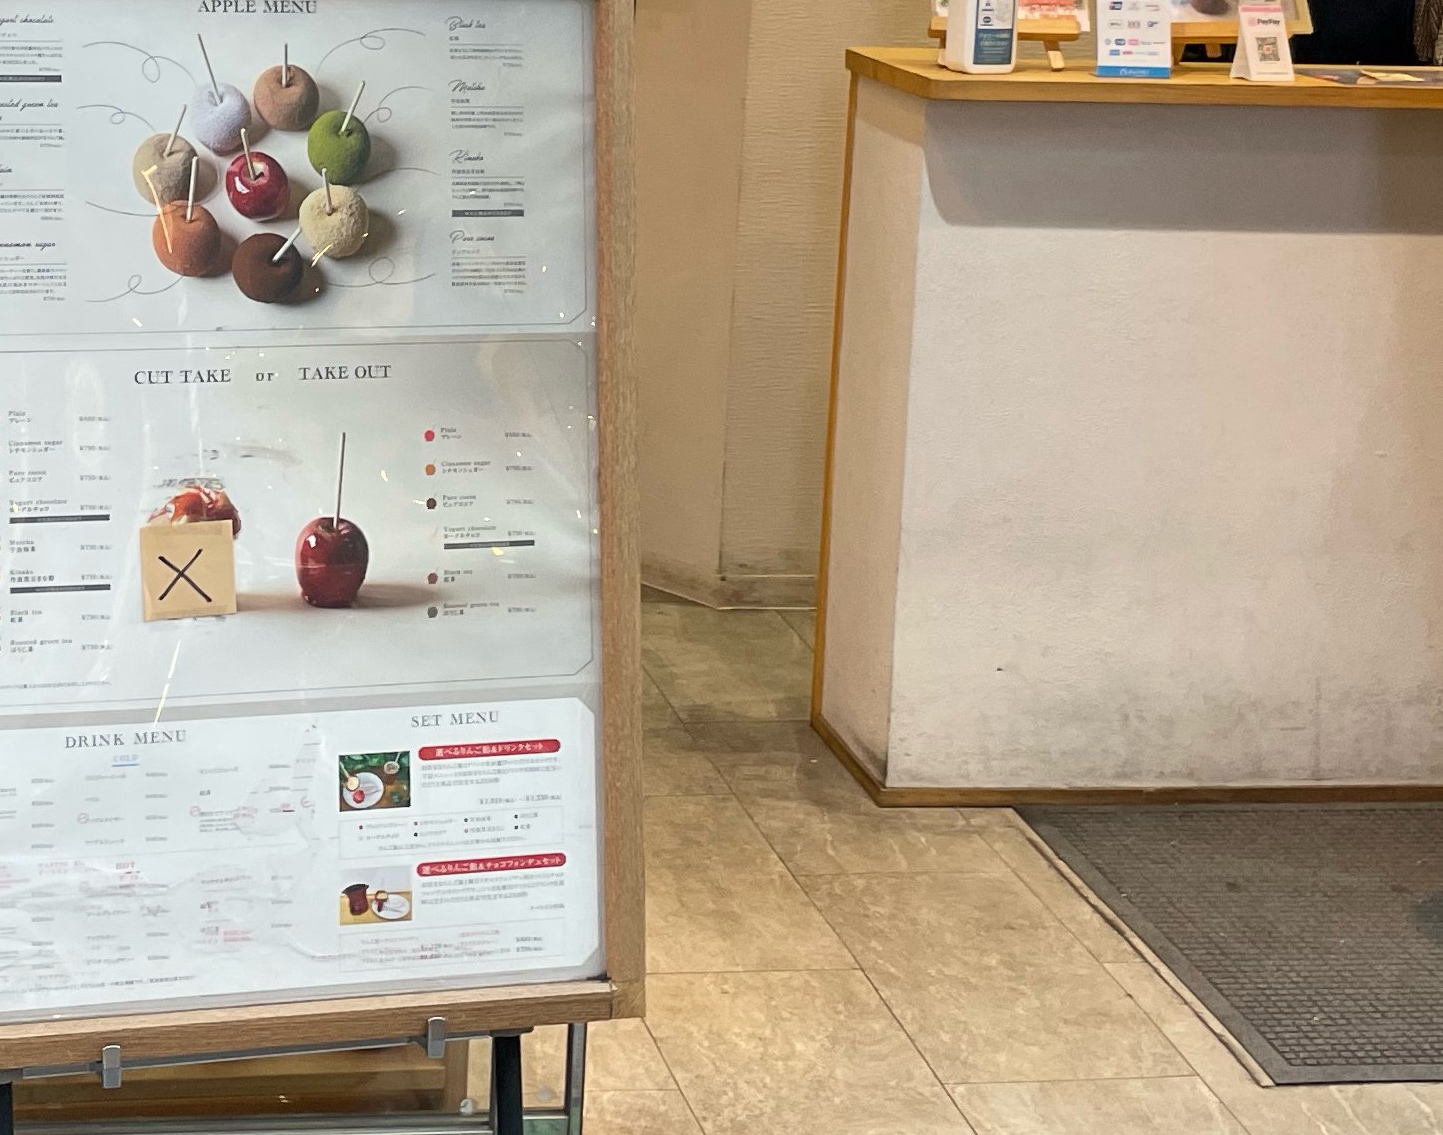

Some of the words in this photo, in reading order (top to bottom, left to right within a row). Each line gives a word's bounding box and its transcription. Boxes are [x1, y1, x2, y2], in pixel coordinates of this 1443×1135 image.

[198, 0, 257, 14] APPLE
[263, 0, 317, 14] MENU
[134, 370, 173, 385] CUT
[180, 369, 232, 384] TAKE
[256, 372, 274, 381] or
[298, 366, 349, 380] TAKE
[354, 364, 392, 379] OUT
[411, 714, 442, 728] SET
[450, 711, 500, 726] MENU
[65, 733, 125, 749] DRINK
[134, 730, 187, 745] MENU
